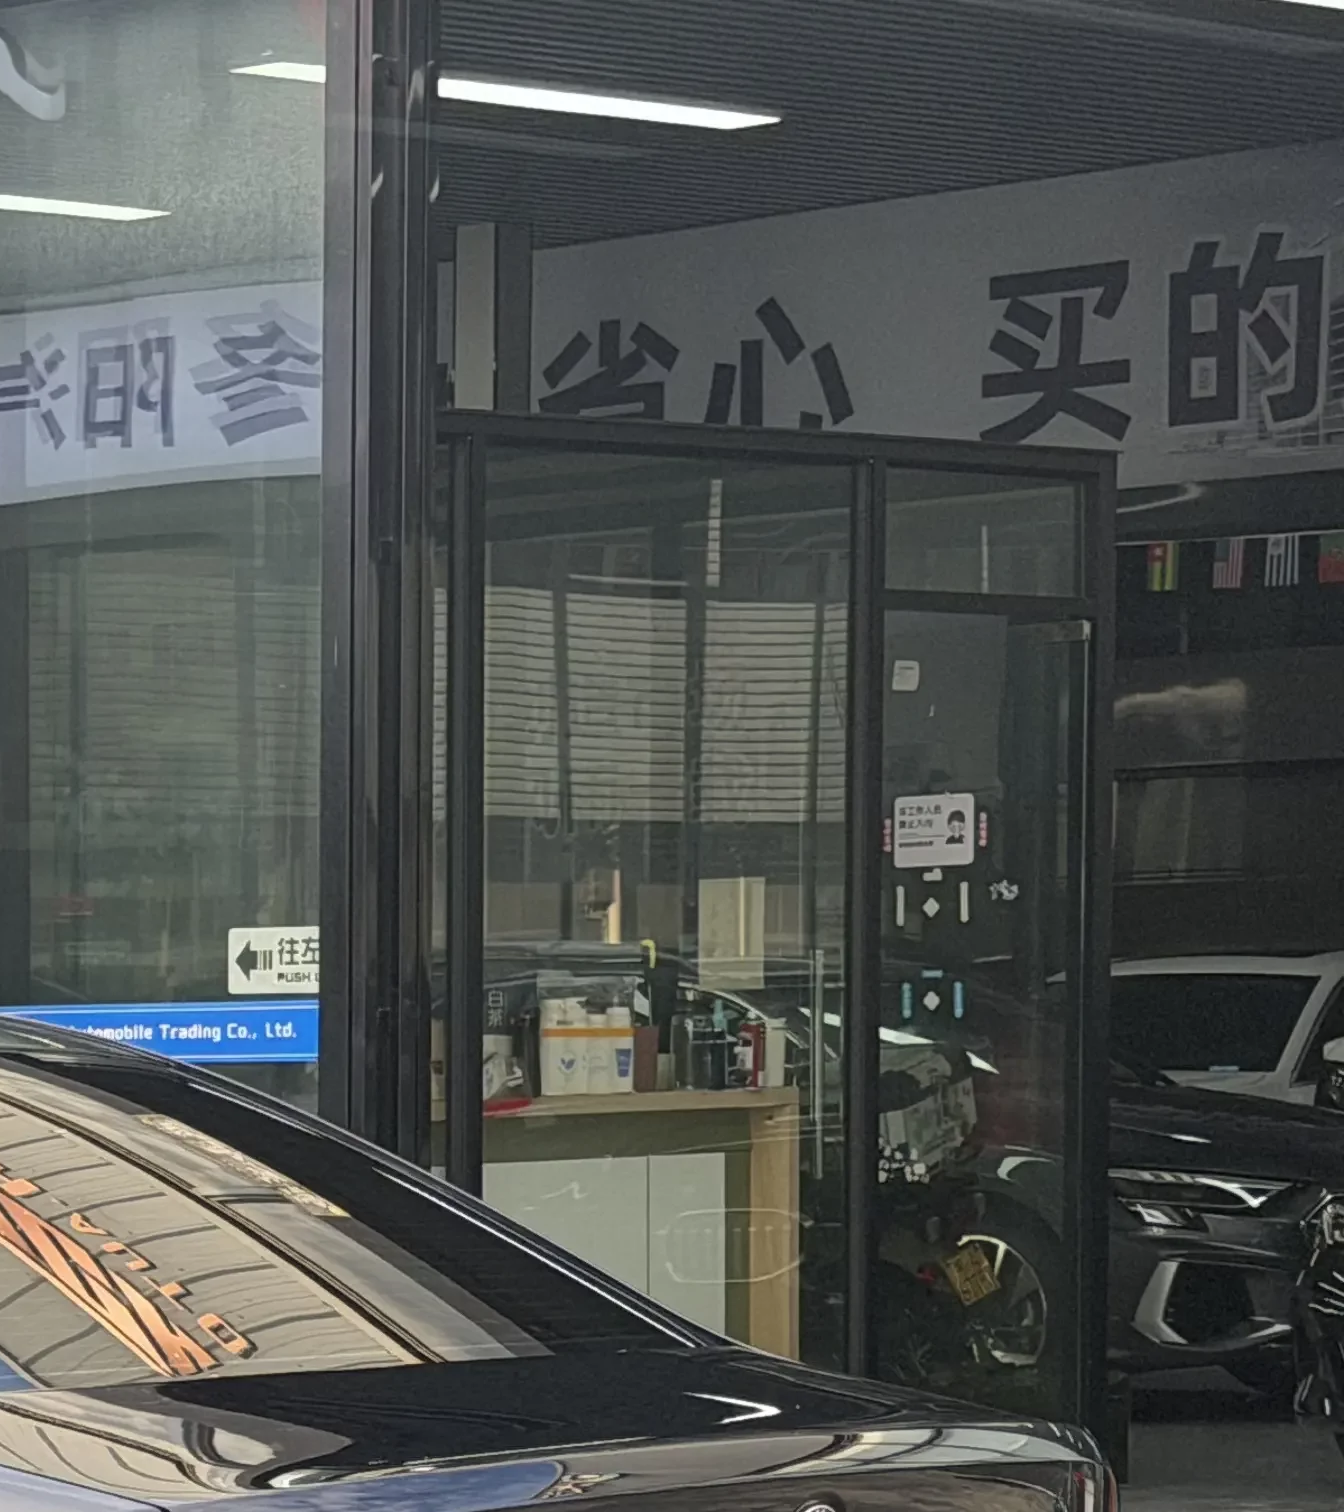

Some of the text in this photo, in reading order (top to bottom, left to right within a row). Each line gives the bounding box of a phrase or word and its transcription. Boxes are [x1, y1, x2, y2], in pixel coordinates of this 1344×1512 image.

[979, 231, 1326, 442] 买的
[277, 972, 311, 983] PUSH
[69, 1024, 153, 1041] tomobile
[159, 1024, 222, 1043] Trading
[265, 1021, 297, 1039] Ltd.
